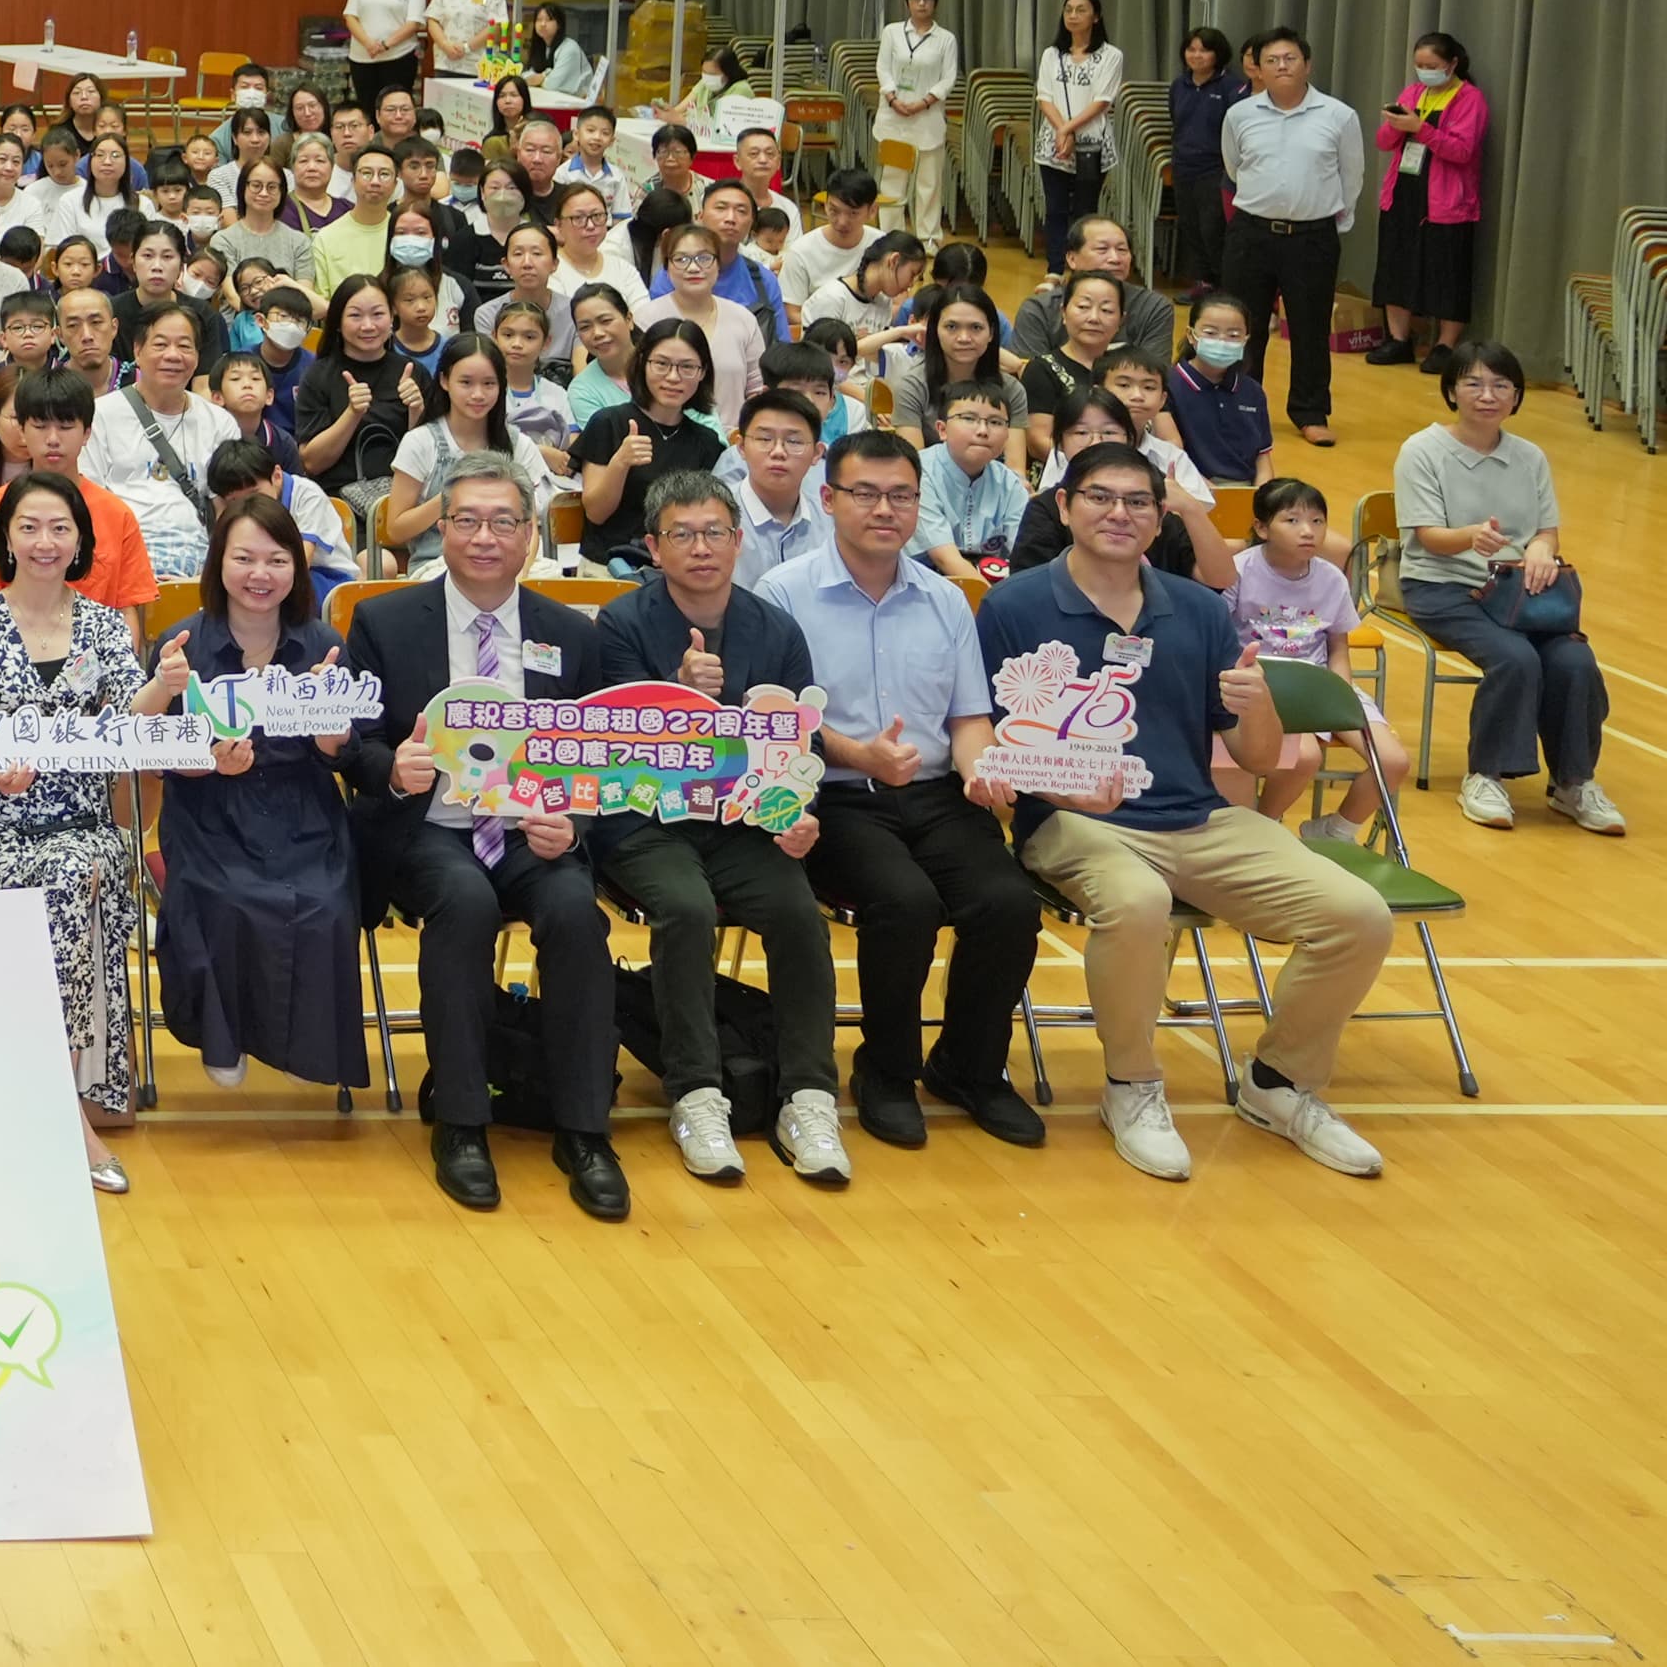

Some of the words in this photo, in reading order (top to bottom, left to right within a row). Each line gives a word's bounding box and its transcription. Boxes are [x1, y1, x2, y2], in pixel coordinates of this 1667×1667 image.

[267, 668, 378, 702] 新西動力
[267, 706, 296, 717] New
[300, 704, 379, 717] Territories
[1057, 668, 1137, 740] 75
[267, 720, 299, 732] West
[303, 720, 347, 731] Power
[445, 699, 799, 741] 慶祝香港回歸祖國27周年暨
[526, 736, 715, 771] 賀國慶75周年
[1068, 743, 1118, 753] 1949-2024
[37, 757, 60, 770] OF
[67, 756, 130, 770] CHINA
[1057, 772, 1067, 780] of
[1069, 772, 1085, 781] the
[1137, 775, 1148, 784] of
